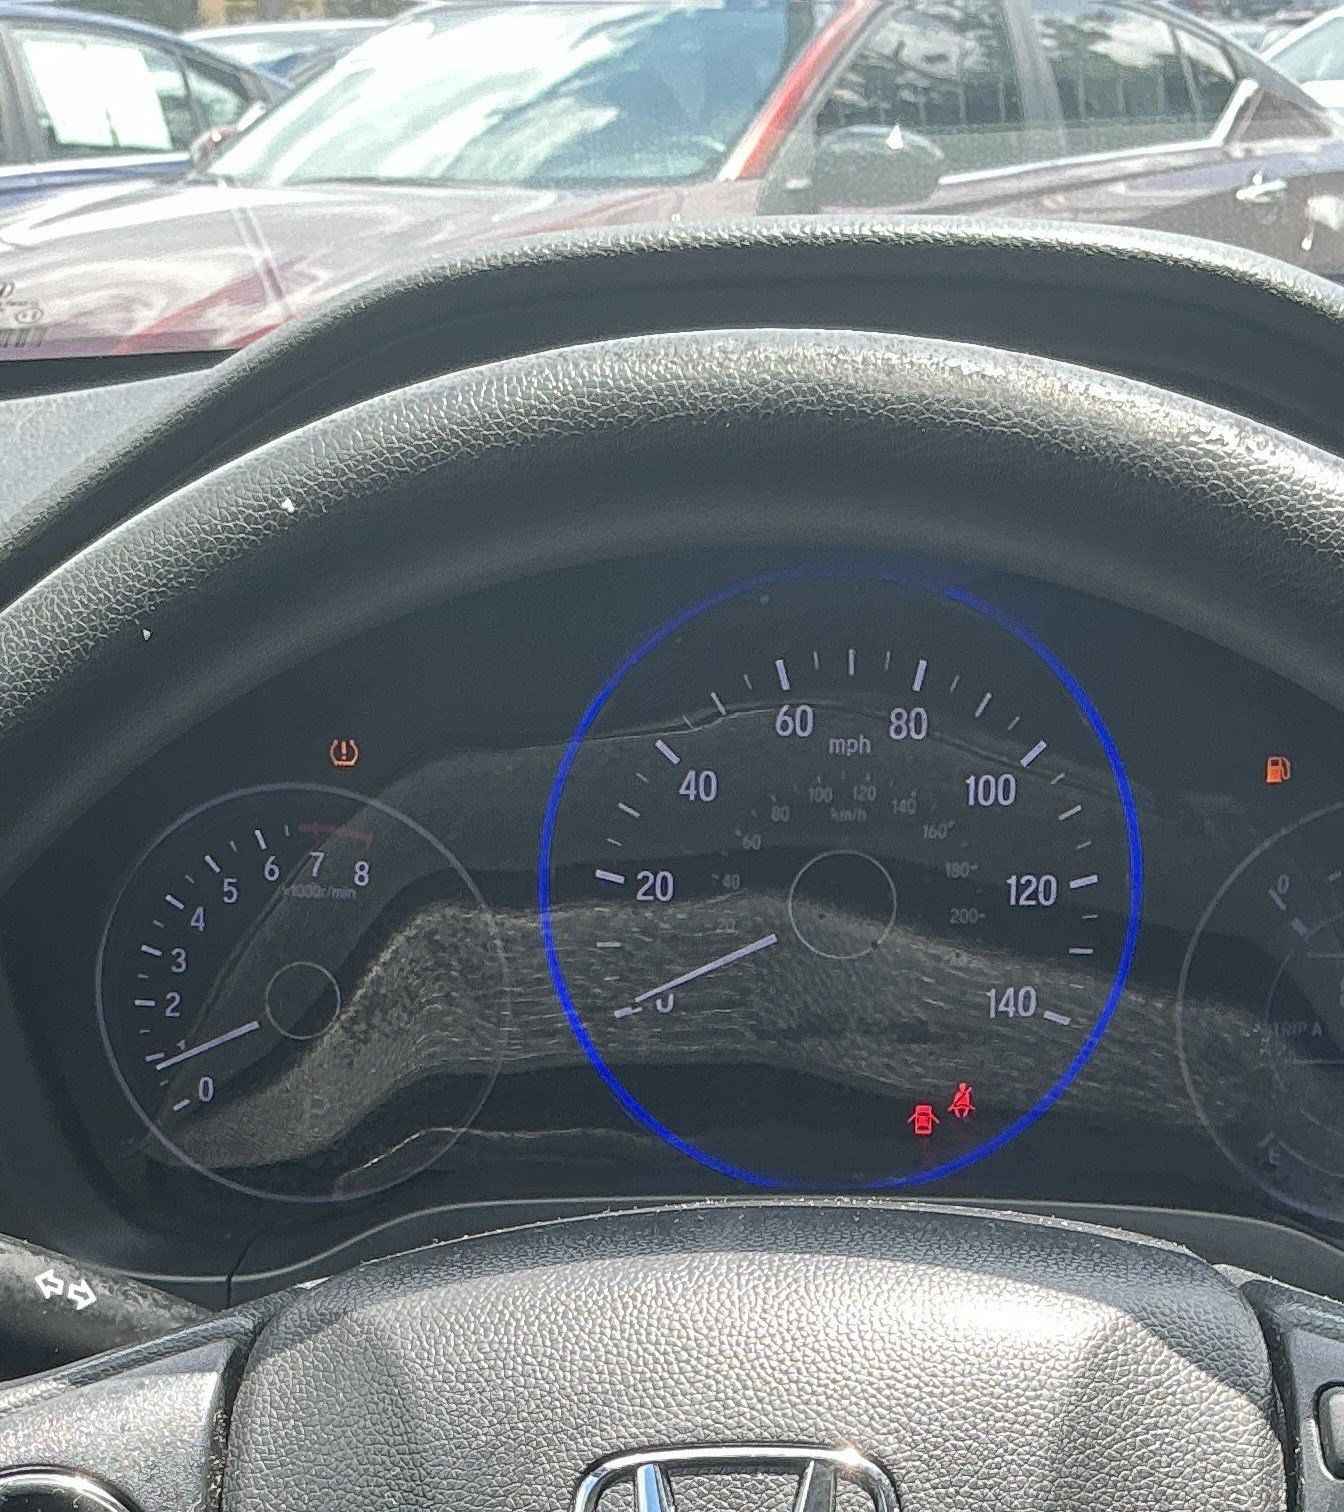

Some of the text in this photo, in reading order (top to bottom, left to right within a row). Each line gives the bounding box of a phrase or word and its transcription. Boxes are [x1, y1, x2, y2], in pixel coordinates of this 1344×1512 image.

[776, 704, 814, 738] 60
[889, 707, 928, 741] 80
[829, 735, 871, 757] mph
[679, 770, 718, 802] 40
[965, 774, 1017, 806] 100
[264, 855, 279, 881] 6
[310, 851, 324, 877] 7
[354, 861, 370, 888] 8
[222, 877, 238, 904] 5
[636, 871, 675, 901] 20
[1006, 874, 1058, 907] 120
[190, 906, 206, 931] 4
[171, 948, 187, 973] 3
[165, 991, 181, 1018] 2
[986, 986, 1037, 1019] 140
[198, 1076, 214, 1102] 0
